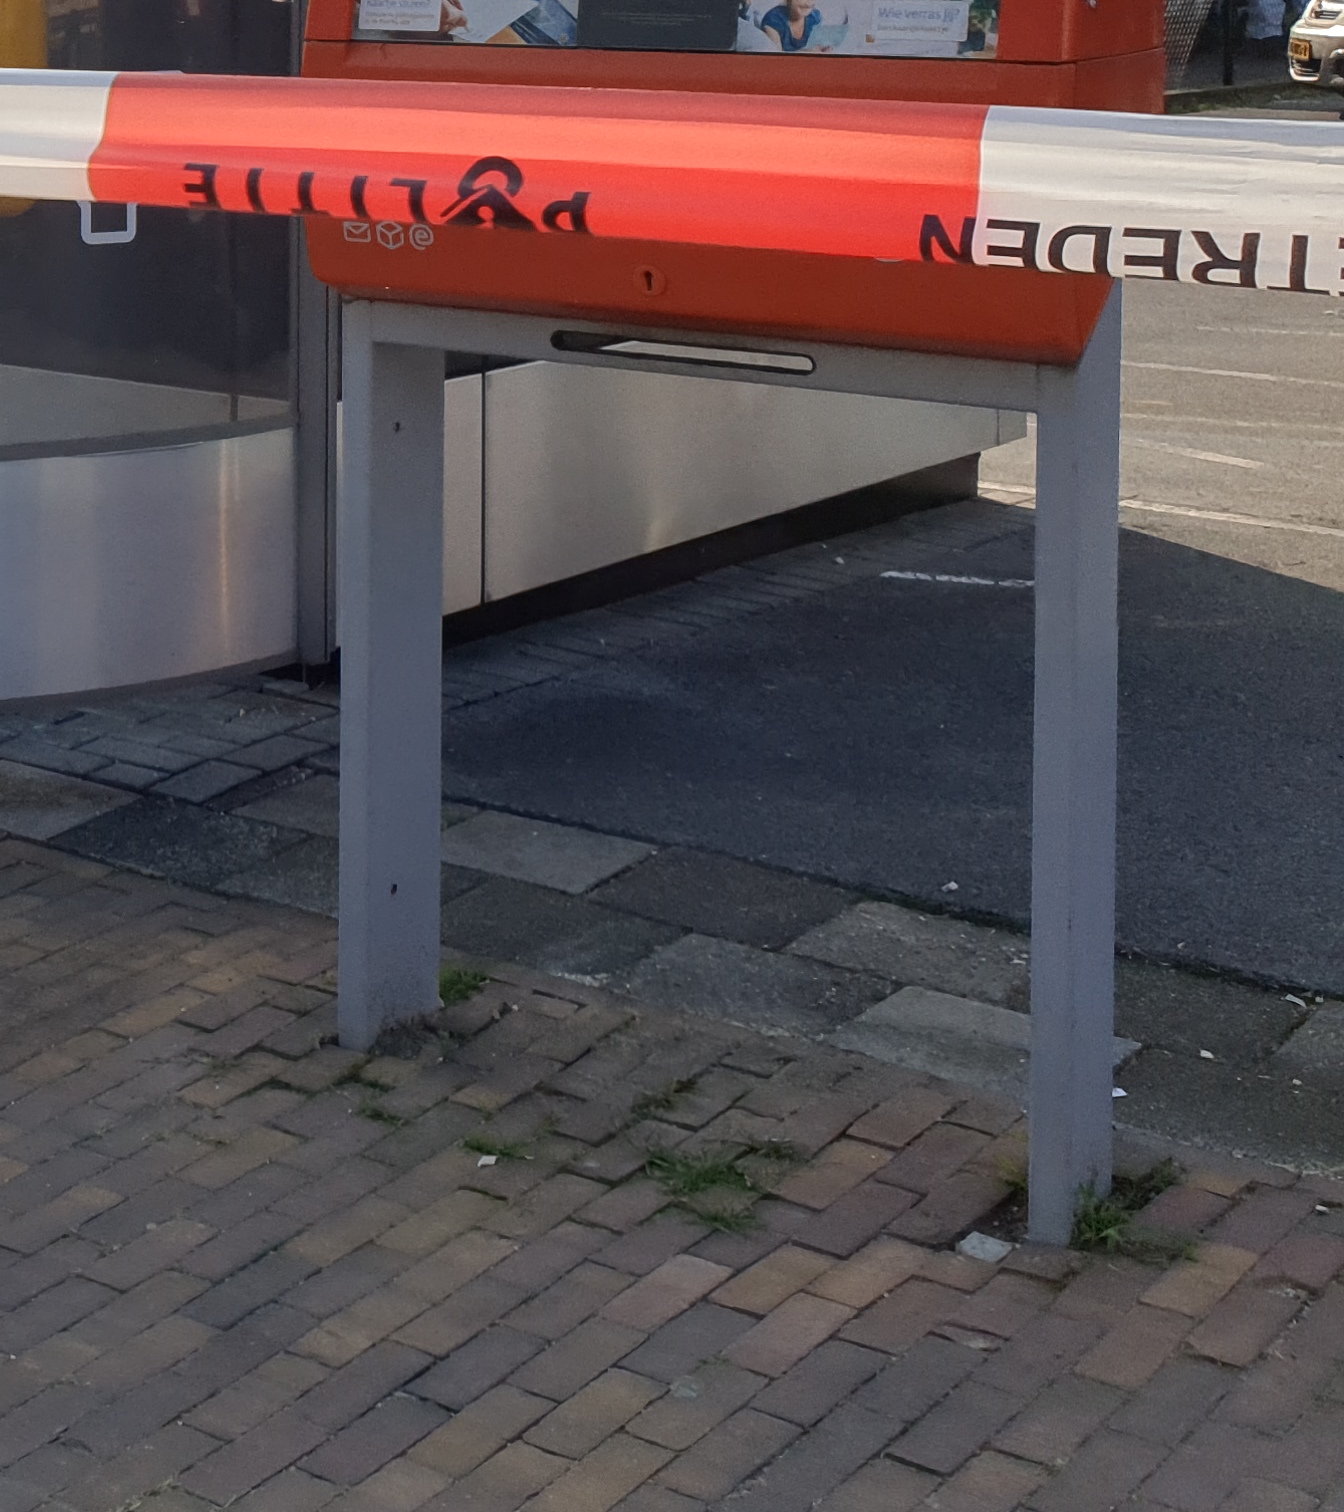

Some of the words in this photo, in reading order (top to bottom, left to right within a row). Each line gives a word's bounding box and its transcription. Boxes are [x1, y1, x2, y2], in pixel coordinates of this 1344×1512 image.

[878, 7, 902, 19] Wie
[904, 8, 941, 20] verras
[918, 214, 1344, 296] TREDEN
